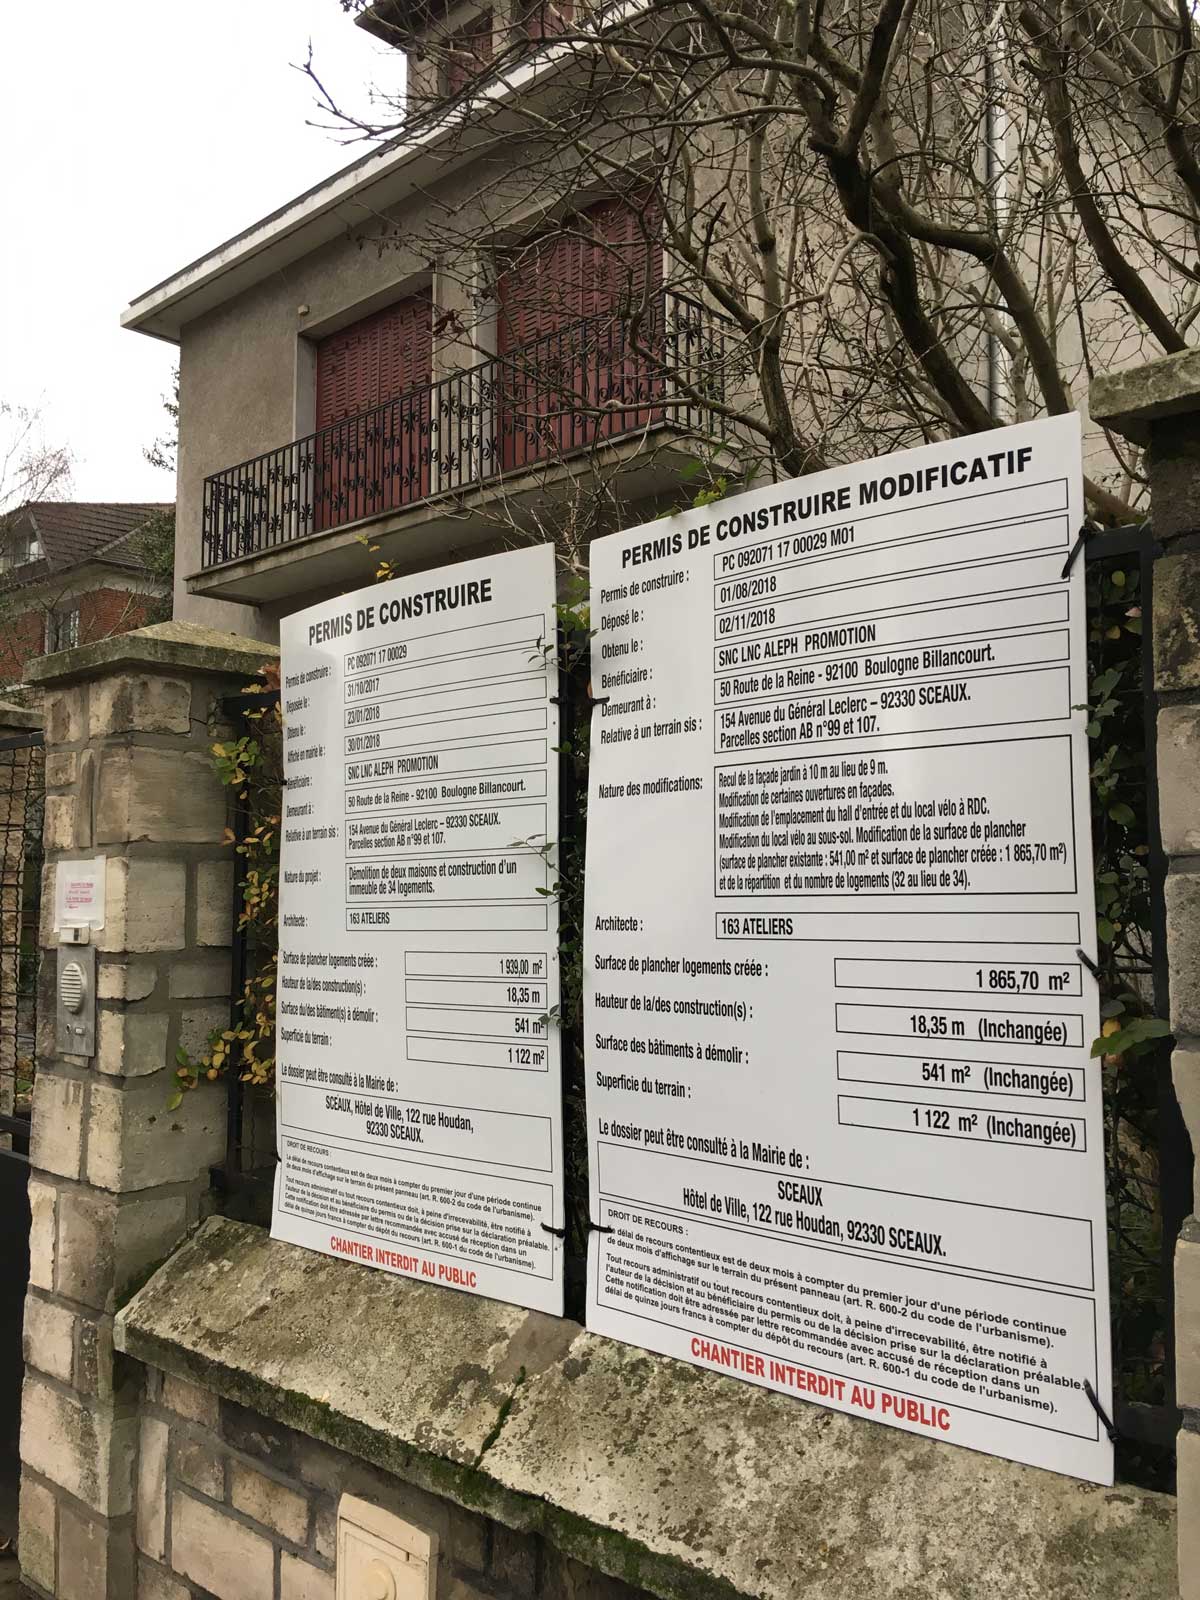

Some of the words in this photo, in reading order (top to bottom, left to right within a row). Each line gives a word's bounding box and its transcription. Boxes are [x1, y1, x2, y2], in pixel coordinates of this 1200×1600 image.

[621, 533, 682, 568] PERMIS
[687, 524, 710, 549] DE
[716, 486, 851, 541] CONSTRUIRE
[859, 446, 1032, 505] MODIFICATIF
[722, 553, 735, 572] PC
[737, 544, 772, 568] 092071
[776, 540, 790, 558] 17
[792, 531, 827, 554] 00029
[830, 525, 854, 546] M01
[600, 583, 627, 604] Permis
[629, 580, 639, 596] de
[641, 569, 684, 593] construire
[720, 575, 776, 603] 01/08/2018
[308, 612, 352, 646] PERMIS
[356, 606, 374, 631] DE
[379, 577, 492, 624] CONSTRUIRE
[601, 609, 629, 631] Déposé
[631, 608, 639, 623] le
[719, 607, 775, 634] 02/11/2018
[347, 656, 355, 670] PC
[355, 650, 376, 668] 092071
[378, 648, 386, 663] 17
[387, 644, 407, 661] 00029
[718, 647, 738, 666] SNC
[741, 643, 761, 662] LNC
[763, 636, 798, 658] ALEPH
[804, 623, 875, 651] PROMOTION
[601, 666, 647, 688] Bénéficiaire
[719, 680, 731, 697] 50
[733, 676, 759, 695] Route
[761, 673, 773, 690] de
[775, 672, 784, 688] la
[786, 668, 815, 687] Reine
[825, 660, 858, 681] 92100
[864, 655, 919, 676] Boulogne
[922, 643, 995, 668] Billancourt.
[347, 677, 379, 697] 31/10/2017
[347, 706, 380, 725] 23/01/2018
[720, 711, 736, 729] 154
[737, 709, 771, 726] Avenue
[773, 705, 785, 722] du
[787, 698, 825, 720] Général
[828, 695, 867, 715] Leclerc
[880, 688, 915, 709] 92330
[918, 682, 970, 705] SCEAUX.
[347, 733, 380, 753] 30/01/2018
[720, 729, 760, 748] Parcelles
[762, 725, 796, 743] section
[799, 721, 813, 739] AB
[843, 717, 853, 734] et
[858, 714, 879, 733] 107.
[347, 765, 359, 780] SNC
[360, 763, 372, 778] LNC
[373, 760, 393, 776] ALEPH
[397, 754, 438, 773] PROMOTION
[718, 790, 759, 808] Modification
[760, 789, 769, 805] de
[770, 786, 803, 804] certaines
[804, 784, 845, 801] ouvertures
[847, 785, 857, 799] en
[859, 780, 894, 802] façades.
[348, 823, 358, 835] 154
[358, 823, 379, 834] Avenue
[380, 821, 388, 833] du
[389, 818, 412, 832] Général
[414, 817, 438, 830] Leclerc
[445, 814, 467, 828] 92330
[468, 811, 500, 827] SCEAUX.
[348, 866, 380, 879] Démolition
[381, 864, 389, 879] de
[390, 864, 406, 878] deux
[407, 863, 437, 877] maisons
[438, 862, 446, 876] et
[447, 859, 496, 876] construction
[349, 912, 360, 924] 163
[360, 911, 390, 924] ATELIERS
[594, 915, 638, 931] Architecte
[721, 917, 739, 934] 163
[742, 917, 793, 935] ATELIERS
[499, 958, 503, 974] 1
[505, 958, 528, 977] 939,00
[594, 953, 626, 970] Surface
[628, 955, 639, 971] de
[641, 955, 680, 975] plancher
[682, 956, 731, 977] logements
[733, 958, 762, 976] créée
[975, 968, 982, 987] 1
[988, 969, 1039, 990] 865,70
[506, 986, 529, 1005] 18,35
[531, 990, 540, 1003] m
[910, 1014, 947, 1034] 18,35
[951, 1020, 964, 1035] m
[977, 1016, 1067, 1044] (Inchangée)
[507, 1047, 512, 1062] 1
[515, 1047, 530, 1064] 122
[921, 1062, 945, 1082] 541
[983, 1066, 1073, 1097] (Inchangée)
[325, 1094, 353, 1115] SCEAUX,
[354, 1099, 372, 1116] Hôtel
[374, 1103, 383, 1118] de
[384, 1104, 403, 1124] Ville,
[405, 1107, 420, 1123] 122
[422, 1112, 436, 1126] rue
[437, 1111, 473, 1133] Houdan,
[366, 1119, 388, 1137] 92330
[389, 1123, 423, 1143] SCEAUX.
[912, 1107, 919, 1126] 1
[924, 1108, 950, 1130] 122
[986, 1114, 1076, 1148] (Inchangée)
[777, 1179, 823, 1206] SCEAUX
[682, 1187, 707, 1210] Hôtel
[709, 1193, 722, 1213] de
[724, 1195, 749, 1222] Ville,
[752, 1201, 772, 1223] 122
[774, 1210, 792, 1228] rue
[795, 1209, 843, 1241] Houdan,
[846, 1219, 885, 1245] 92330
[888, 1226, 946, 1256] SCEAUX.
[330, 1235, 373, 1261] CHANTIER
[375, 1247, 418, 1273] INTERDIT
[421, 1260, 435, 1277] AU
[438, 1263, 476, 1288] PUBLIC
[606, 1235, 615, 1245] de
[616, 1238, 634, 1250] deux
[635, 1244, 653, 1254] mois
[697, 1260, 710, 1269] sur
[711, 1262, 719, 1272] le
[720, 1265, 748, 1279] terrain
[750, 1272, 761, 1283] du
[763, 1277, 797, 1292] présent
[799, 1286, 840, 1302] panneau
[842, 1294, 862, 1307] (art.
[865, 1298, 876, 1310] R.
[878, 1302, 907, 1317] 600-2
[910, 1309, 924, 1320] du
[927, 1314, 955, 1327] code
[958, 1319, 972, 1330] de
[690, 1337, 765, 1377] CHANTIER
[769, 1360, 845, 1401] INTERDIT
[850, 1384, 875, 1409] AU
[881, 1392, 950, 1430] PUBLIC
